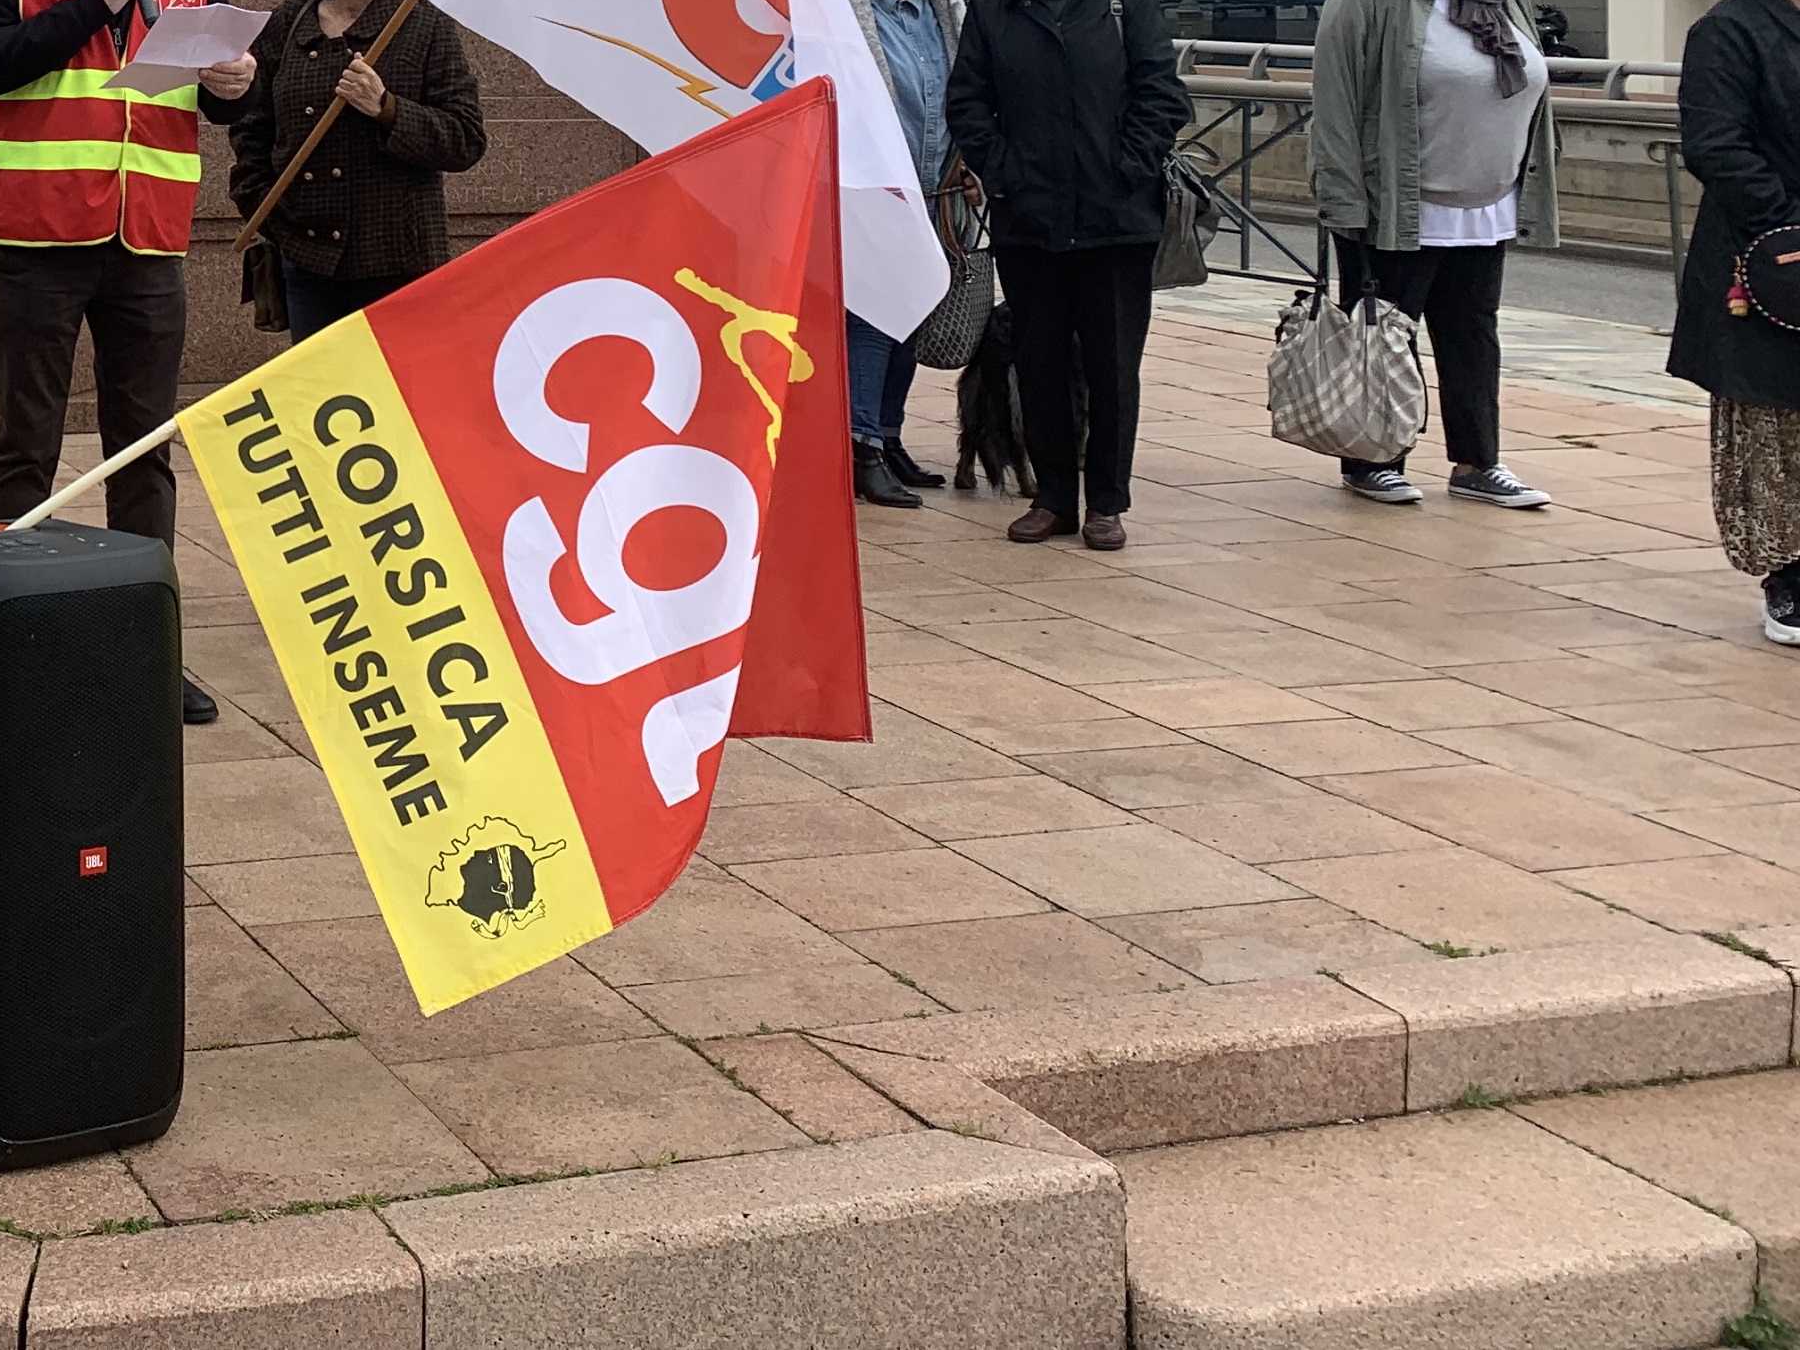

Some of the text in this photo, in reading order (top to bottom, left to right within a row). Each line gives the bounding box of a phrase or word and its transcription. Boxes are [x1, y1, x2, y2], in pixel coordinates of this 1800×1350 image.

[222, 388, 449, 827] TUTTI INSEME
[312, 392, 509, 765] CORSICA
[85, 854, 103, 869] JBL
